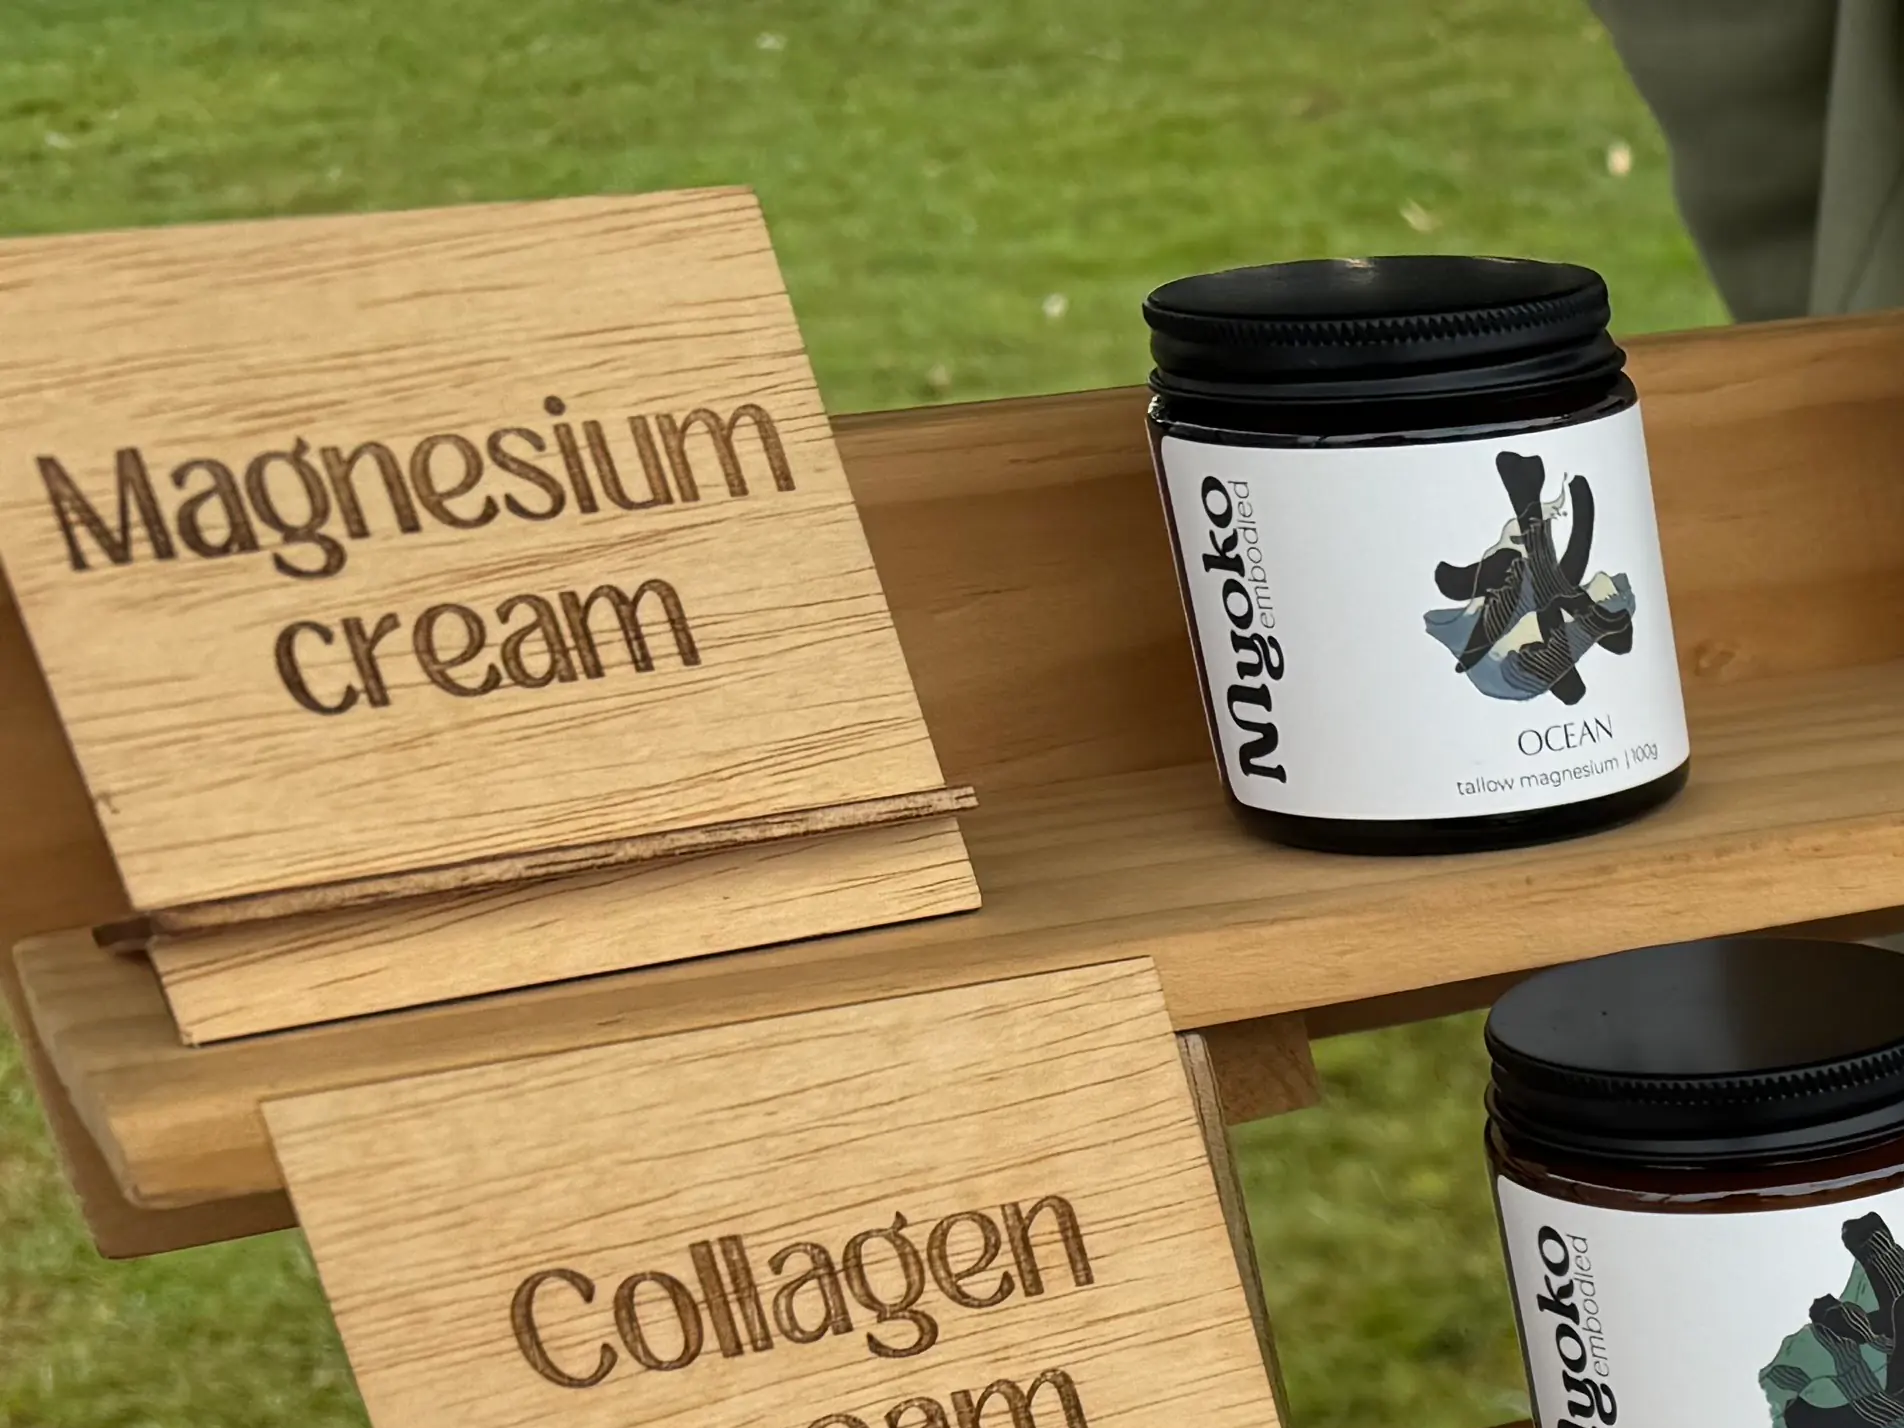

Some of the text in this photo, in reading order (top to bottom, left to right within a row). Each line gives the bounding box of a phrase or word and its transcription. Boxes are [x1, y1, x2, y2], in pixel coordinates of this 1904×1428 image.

[37, 396, 795, 579] Magnesium
[1227, 480, 1276, 629] embodied
[273, 578, 701, 715] cream
[1200, 475, 1286, 784] Myoko
[1457, 777, 1514, 796] tallow
[1520, 757, 1619, 788] magnesium
[1517, 715, 1614, 756] OCEAN
[510, 1195, 1095, 1388] Collagen
[1574, 1233, 1610, 1378] embodied
